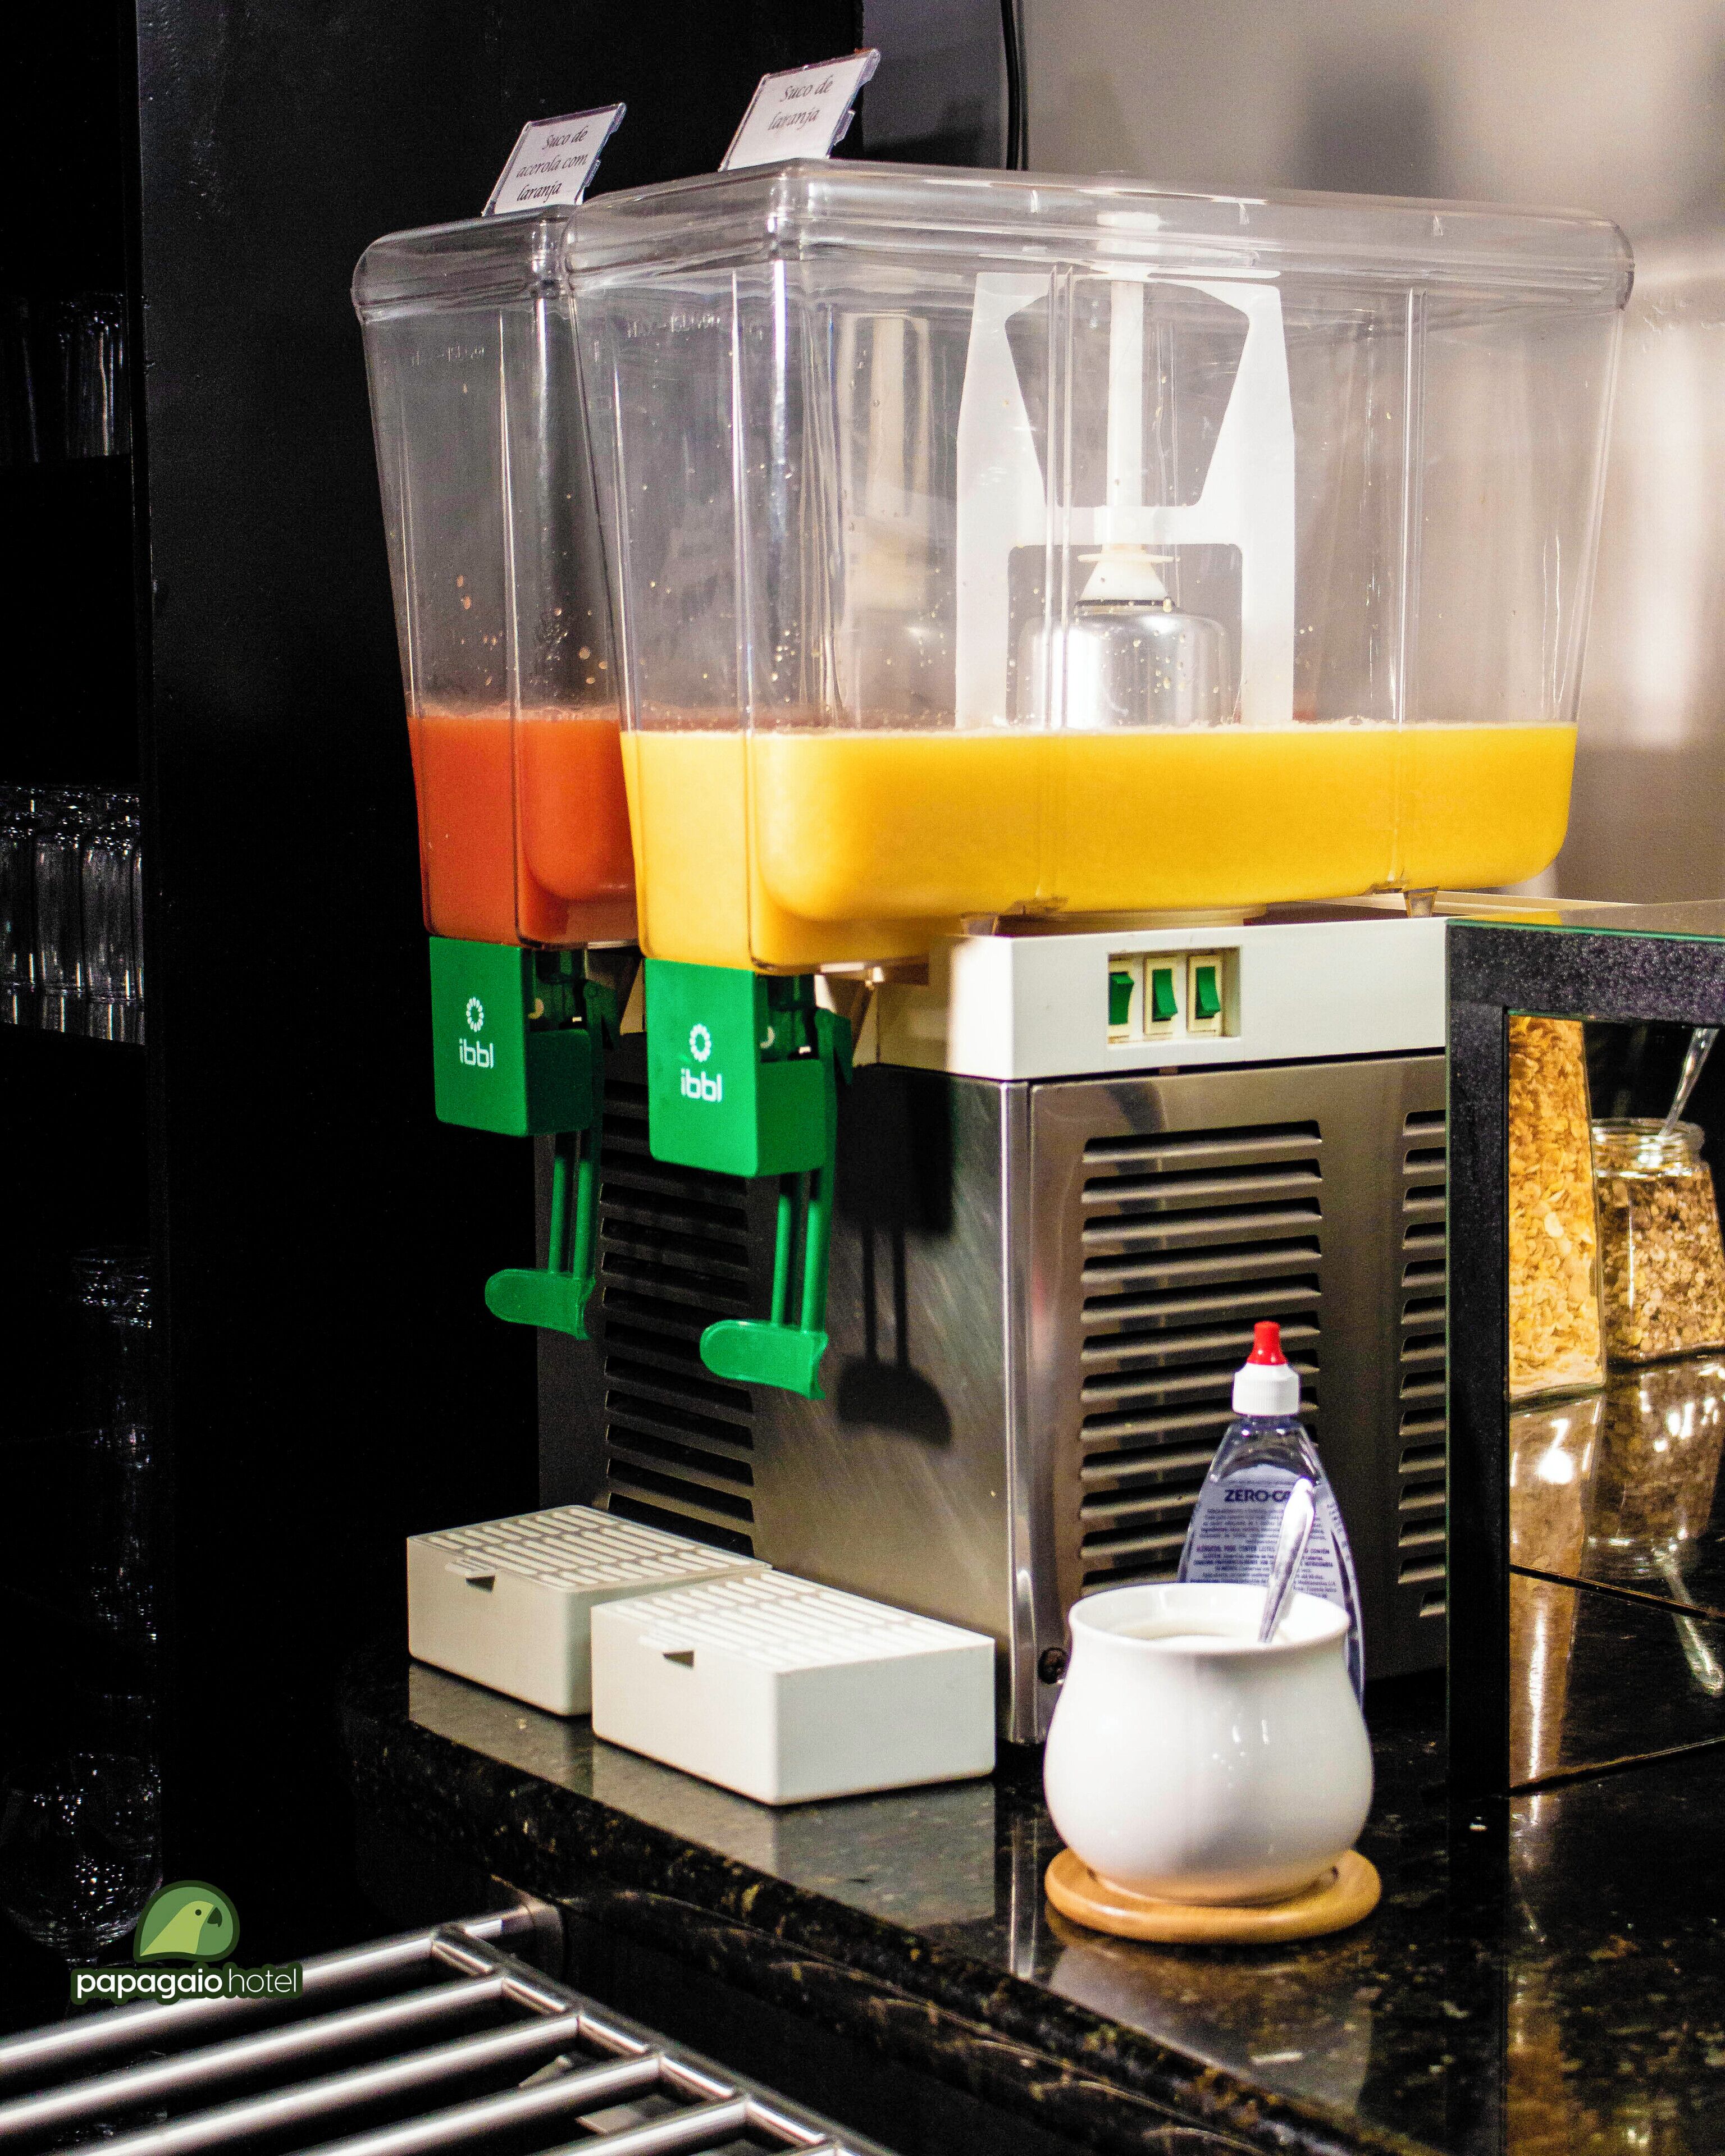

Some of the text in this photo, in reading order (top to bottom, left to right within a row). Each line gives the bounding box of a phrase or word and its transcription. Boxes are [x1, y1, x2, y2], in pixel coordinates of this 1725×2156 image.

[780, 75, 834, 102] Suco de
[768, 107, 820, 130] laranja
[542, 125, 588, 150] Suco de
[516, 153, 588, 178] acerola com
[517, 180, 563, 203] laranja
[459, 1038, 494, 1069] ibbl
[680, 1068, 723, 1103] ibbl
